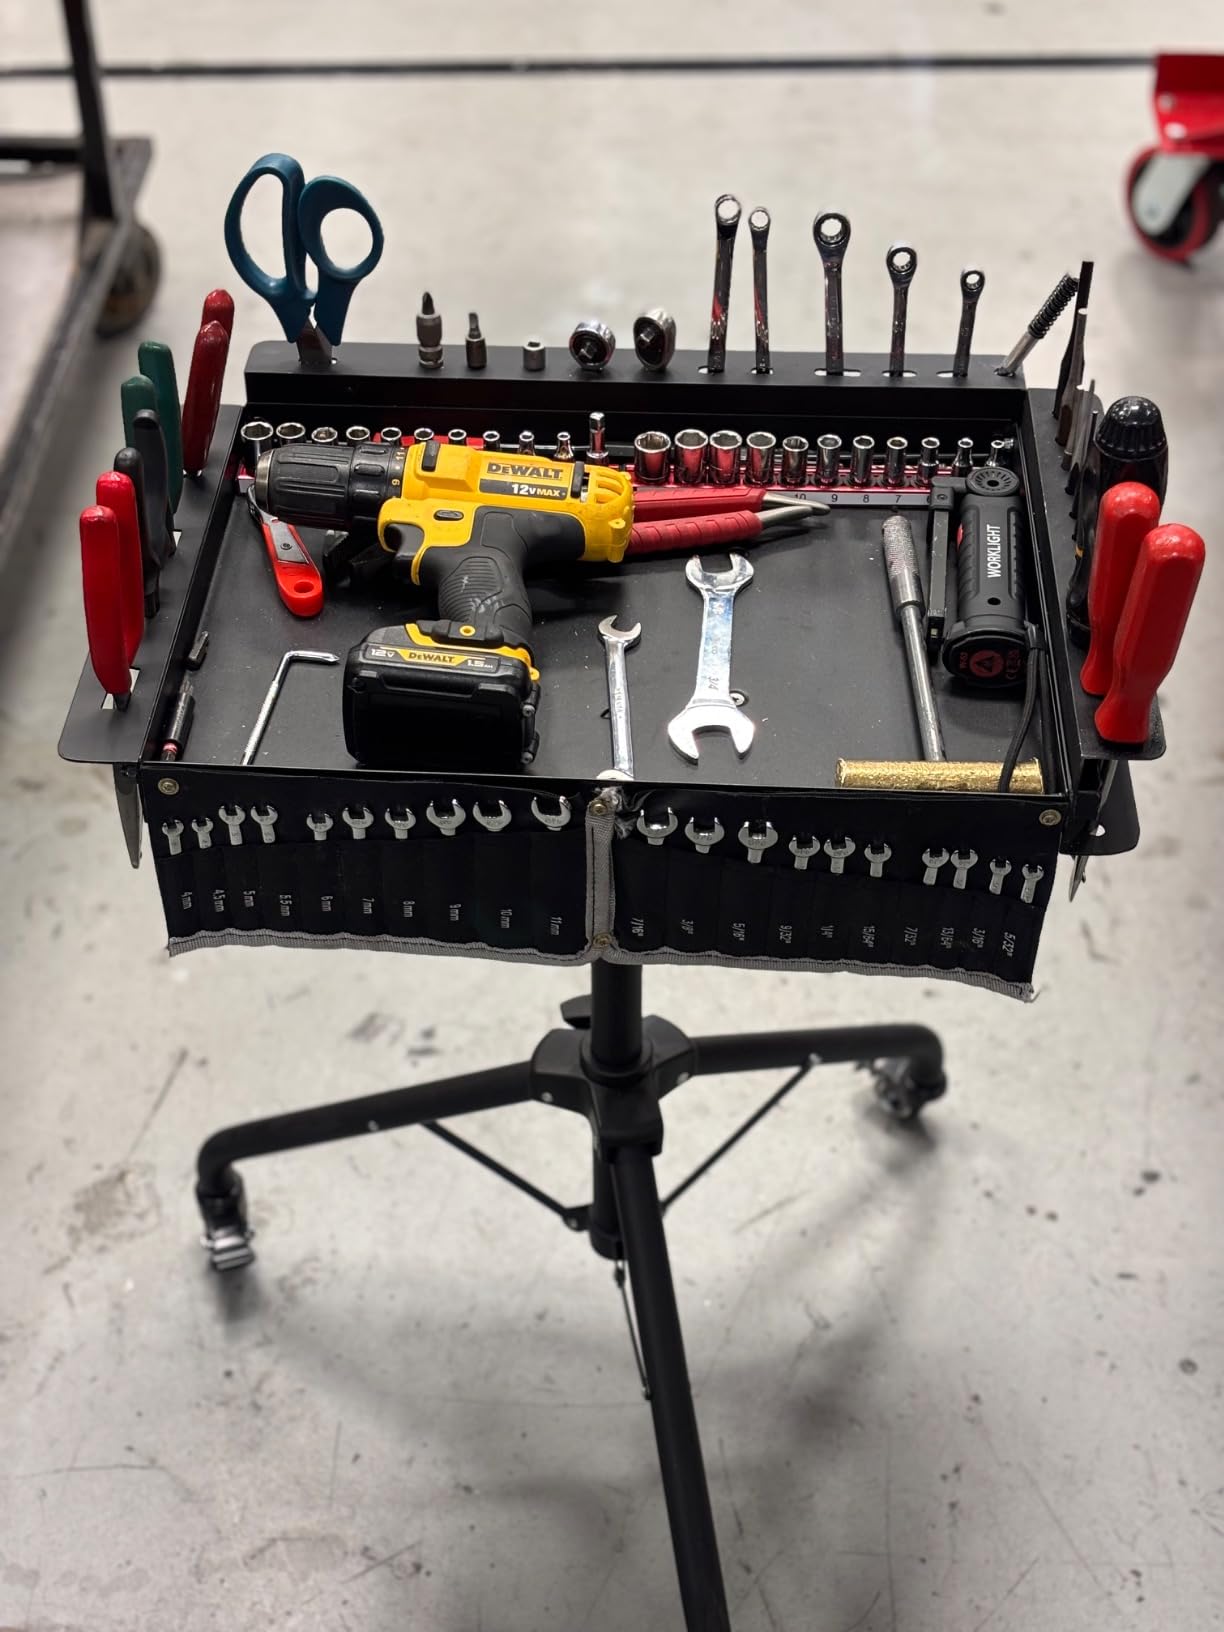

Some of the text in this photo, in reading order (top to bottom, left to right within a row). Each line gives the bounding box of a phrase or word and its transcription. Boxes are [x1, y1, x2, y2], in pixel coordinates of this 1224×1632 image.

[395, 451, 406, 461] 11
[486, 462, 563, 480] DEWALT
[831, 493, 838, 503] 9
[863, 493, 870, 503] 8
[895, 494, 902, 504] 7
[986, 523, 1002, 579] WORKLIGHT
[408, 652, 456, 664] DEWALT
